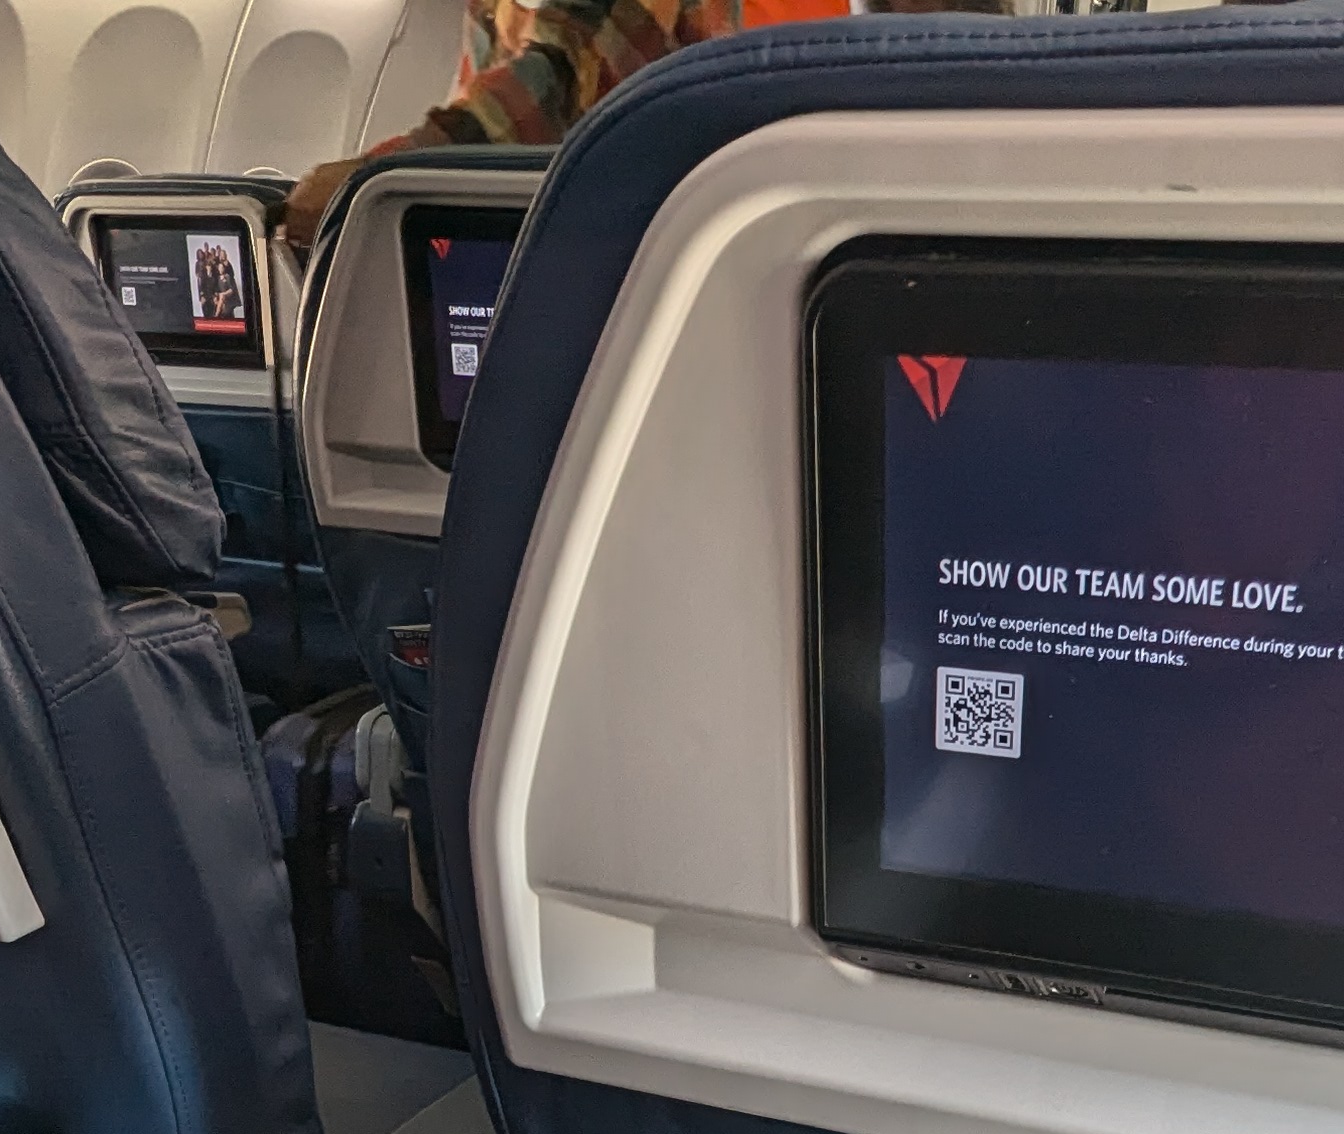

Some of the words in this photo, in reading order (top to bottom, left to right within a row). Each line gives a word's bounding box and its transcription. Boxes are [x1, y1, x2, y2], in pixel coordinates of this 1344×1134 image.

[939, 558, 1011, 589] SHOW
[1017, 565, 1068, 594] OUR
[1075, 569, 1145, 600] TEAM
[1152, 575, 1225, 607] SOME
[1231, 581, 1304, 613] LOVE.
[938, 632, 970, 646] scan
[973, 633, 996, 648] the
[999, 637, 1034, 652] code
[1037, 639, 1052, 654] to
[1055, 641, 1095, 658] share
[1098, 648, 1131, 661] your
[1134, 648, 1188, 667] thanks.
[939, 609, 949, 624] If
[951, 612, 996, 628] you've
[999, 618, 1087, 637] experienced
[1090, 623, 1114, 639] the
[1117, 625, 1157, 643] Delta
[1161, 629, 1240, 650] Difference
[1244, 637, 1295, 658] during
[1298, 643, 1334, 660] your
